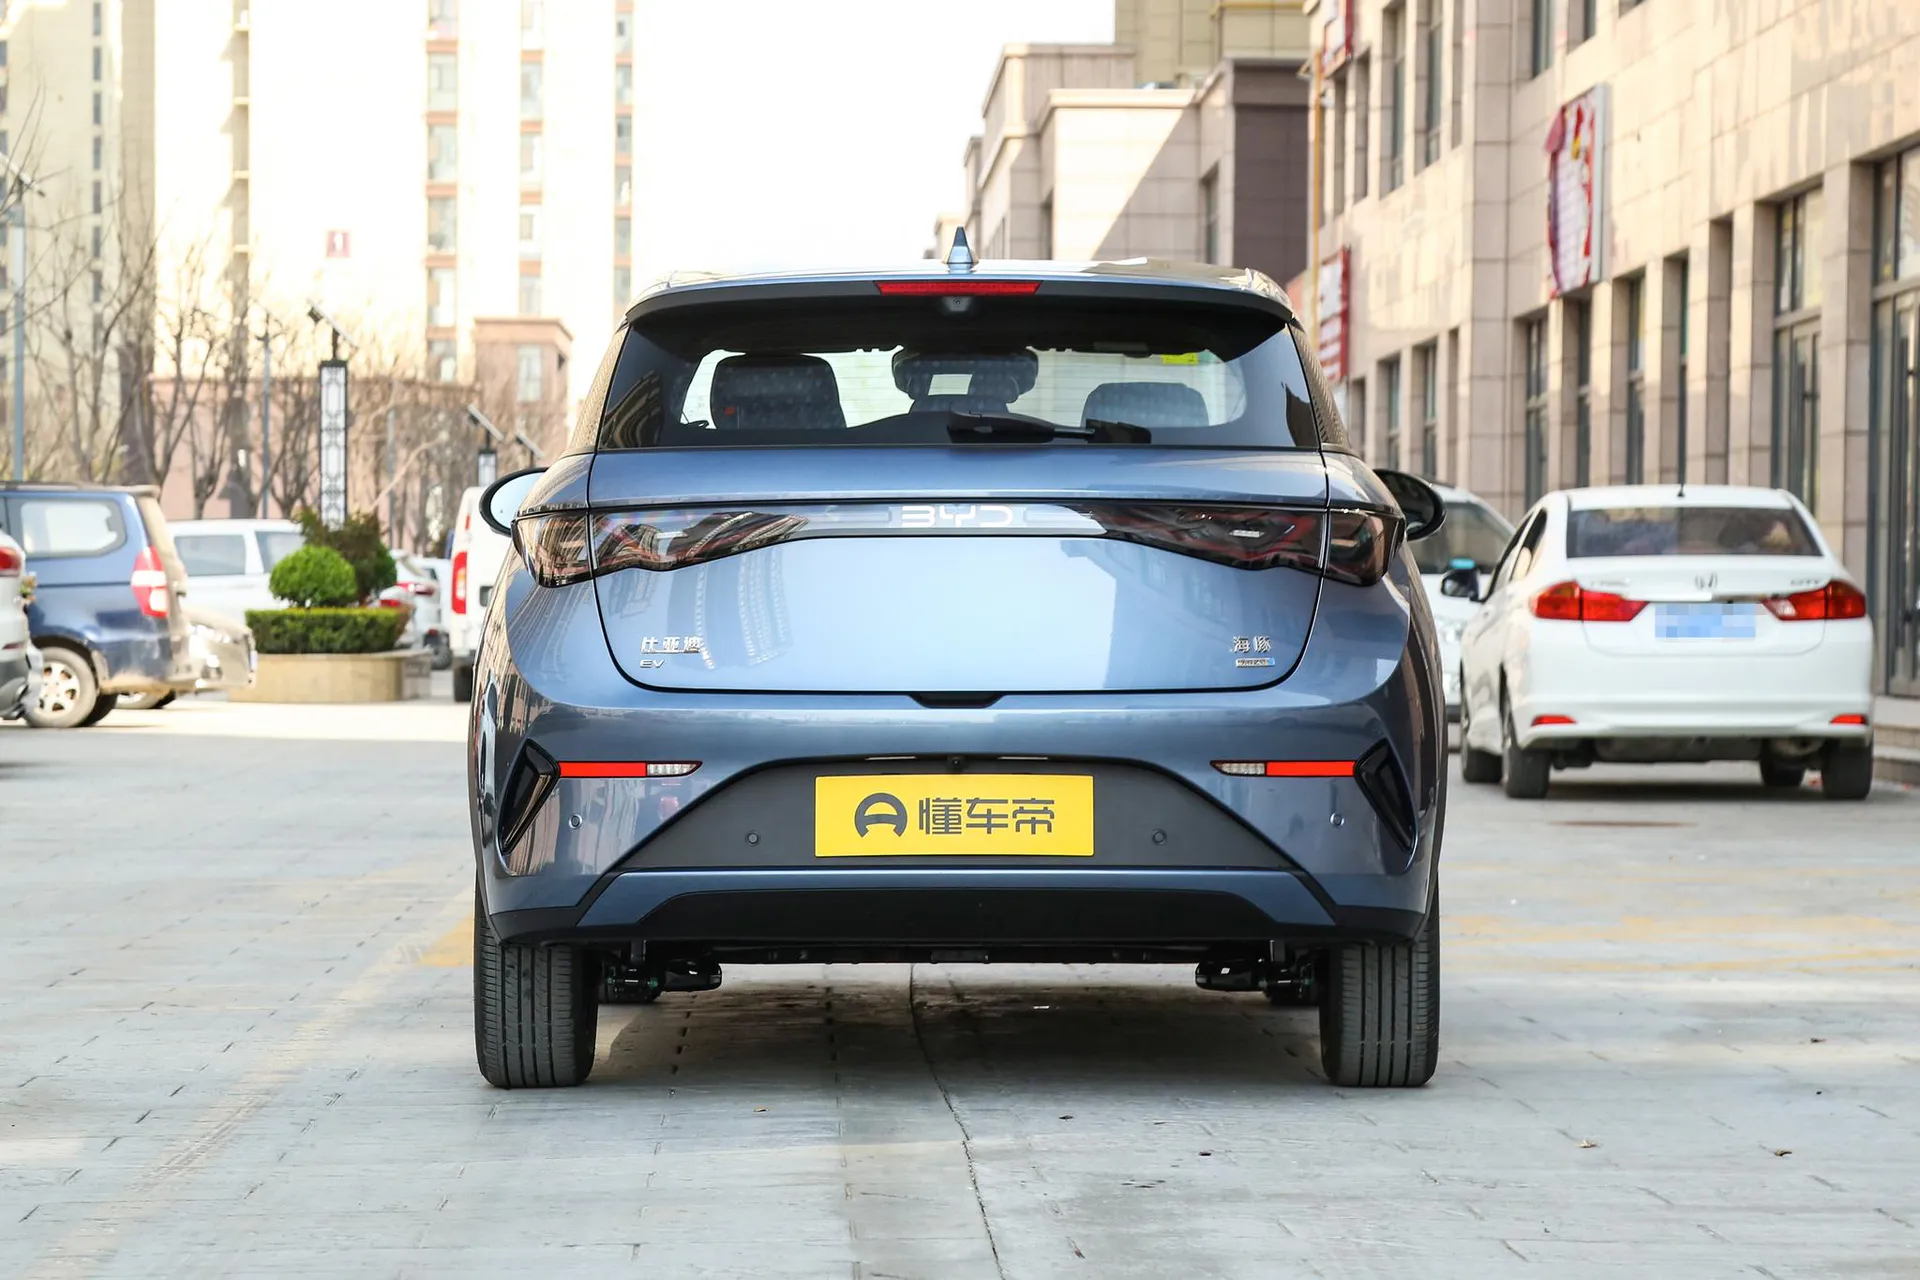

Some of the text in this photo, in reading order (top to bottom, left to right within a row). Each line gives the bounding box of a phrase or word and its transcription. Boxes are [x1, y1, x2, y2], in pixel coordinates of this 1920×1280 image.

[901, 505, 1013, 527] BYD
[640, 636, 703, 654] 比亚迪
[1230, 635, 1272, 653] 海豚
[640, 659, 665, 668] EV
[918, 797, 1055, 835] 懂车帝
